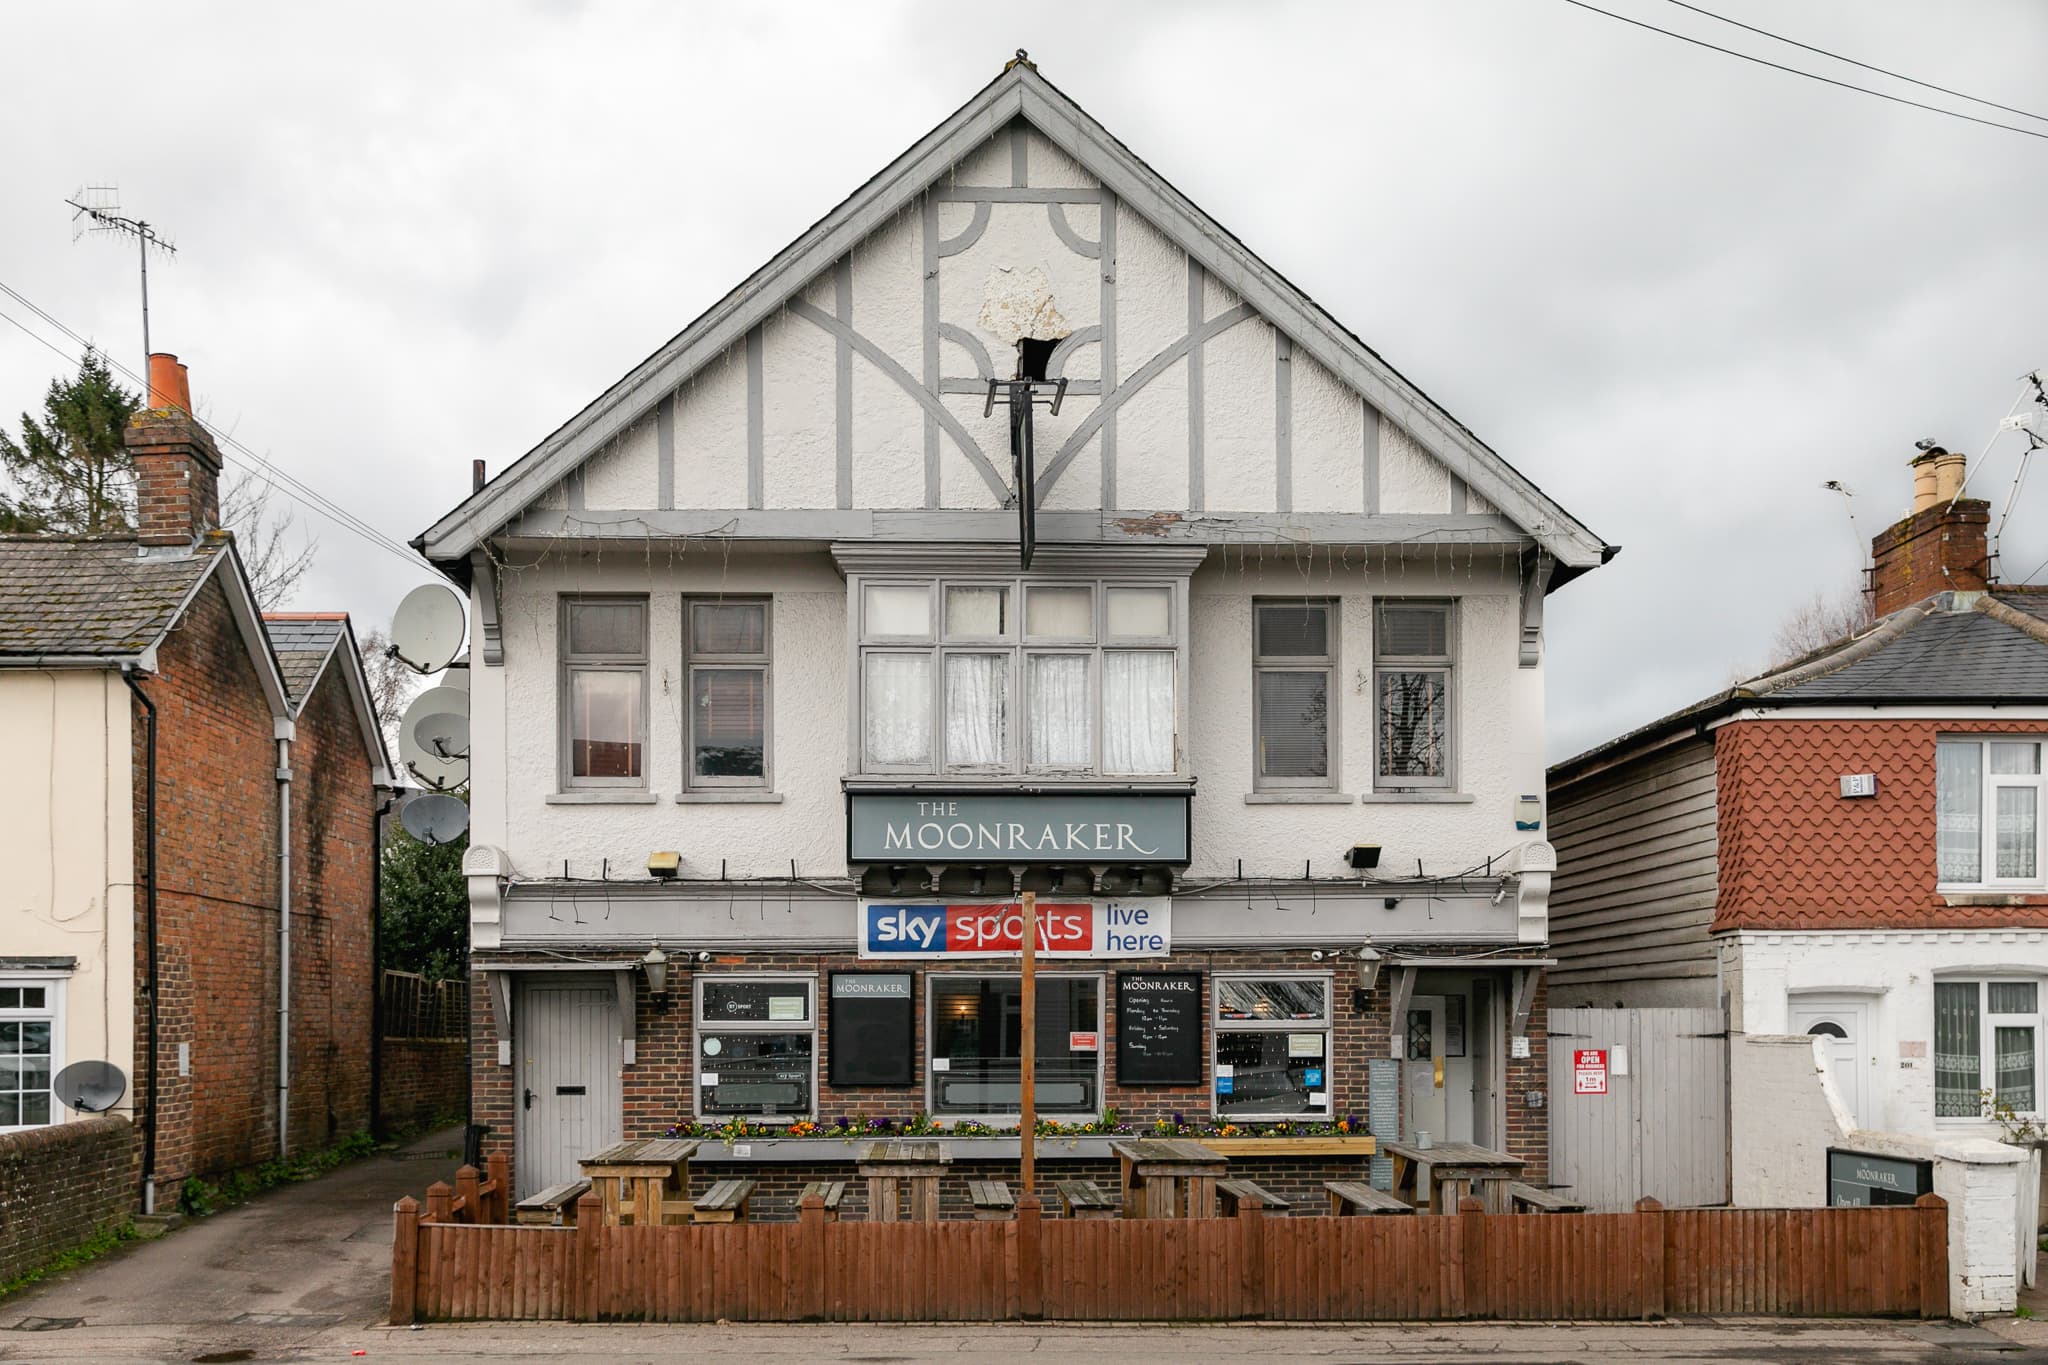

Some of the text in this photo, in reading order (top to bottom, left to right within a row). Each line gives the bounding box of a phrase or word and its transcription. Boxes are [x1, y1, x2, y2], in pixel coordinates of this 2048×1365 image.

[917, 802, 958, 816] THE
[883, 822, 1159, 854] MOONRAKER
[1107, 904, 1149, 925] live
[877, 909, 941, 948] sky
[1107, 930, 1163, 951] here
[836, 984, 907, 993] MOONRAKER
[1122, 981, 1195, 992] MOONRAKER
[1581, 1056, 1600, 1064] OPEN
[1856, 1168, 1899, 1186] MOONRAKER
